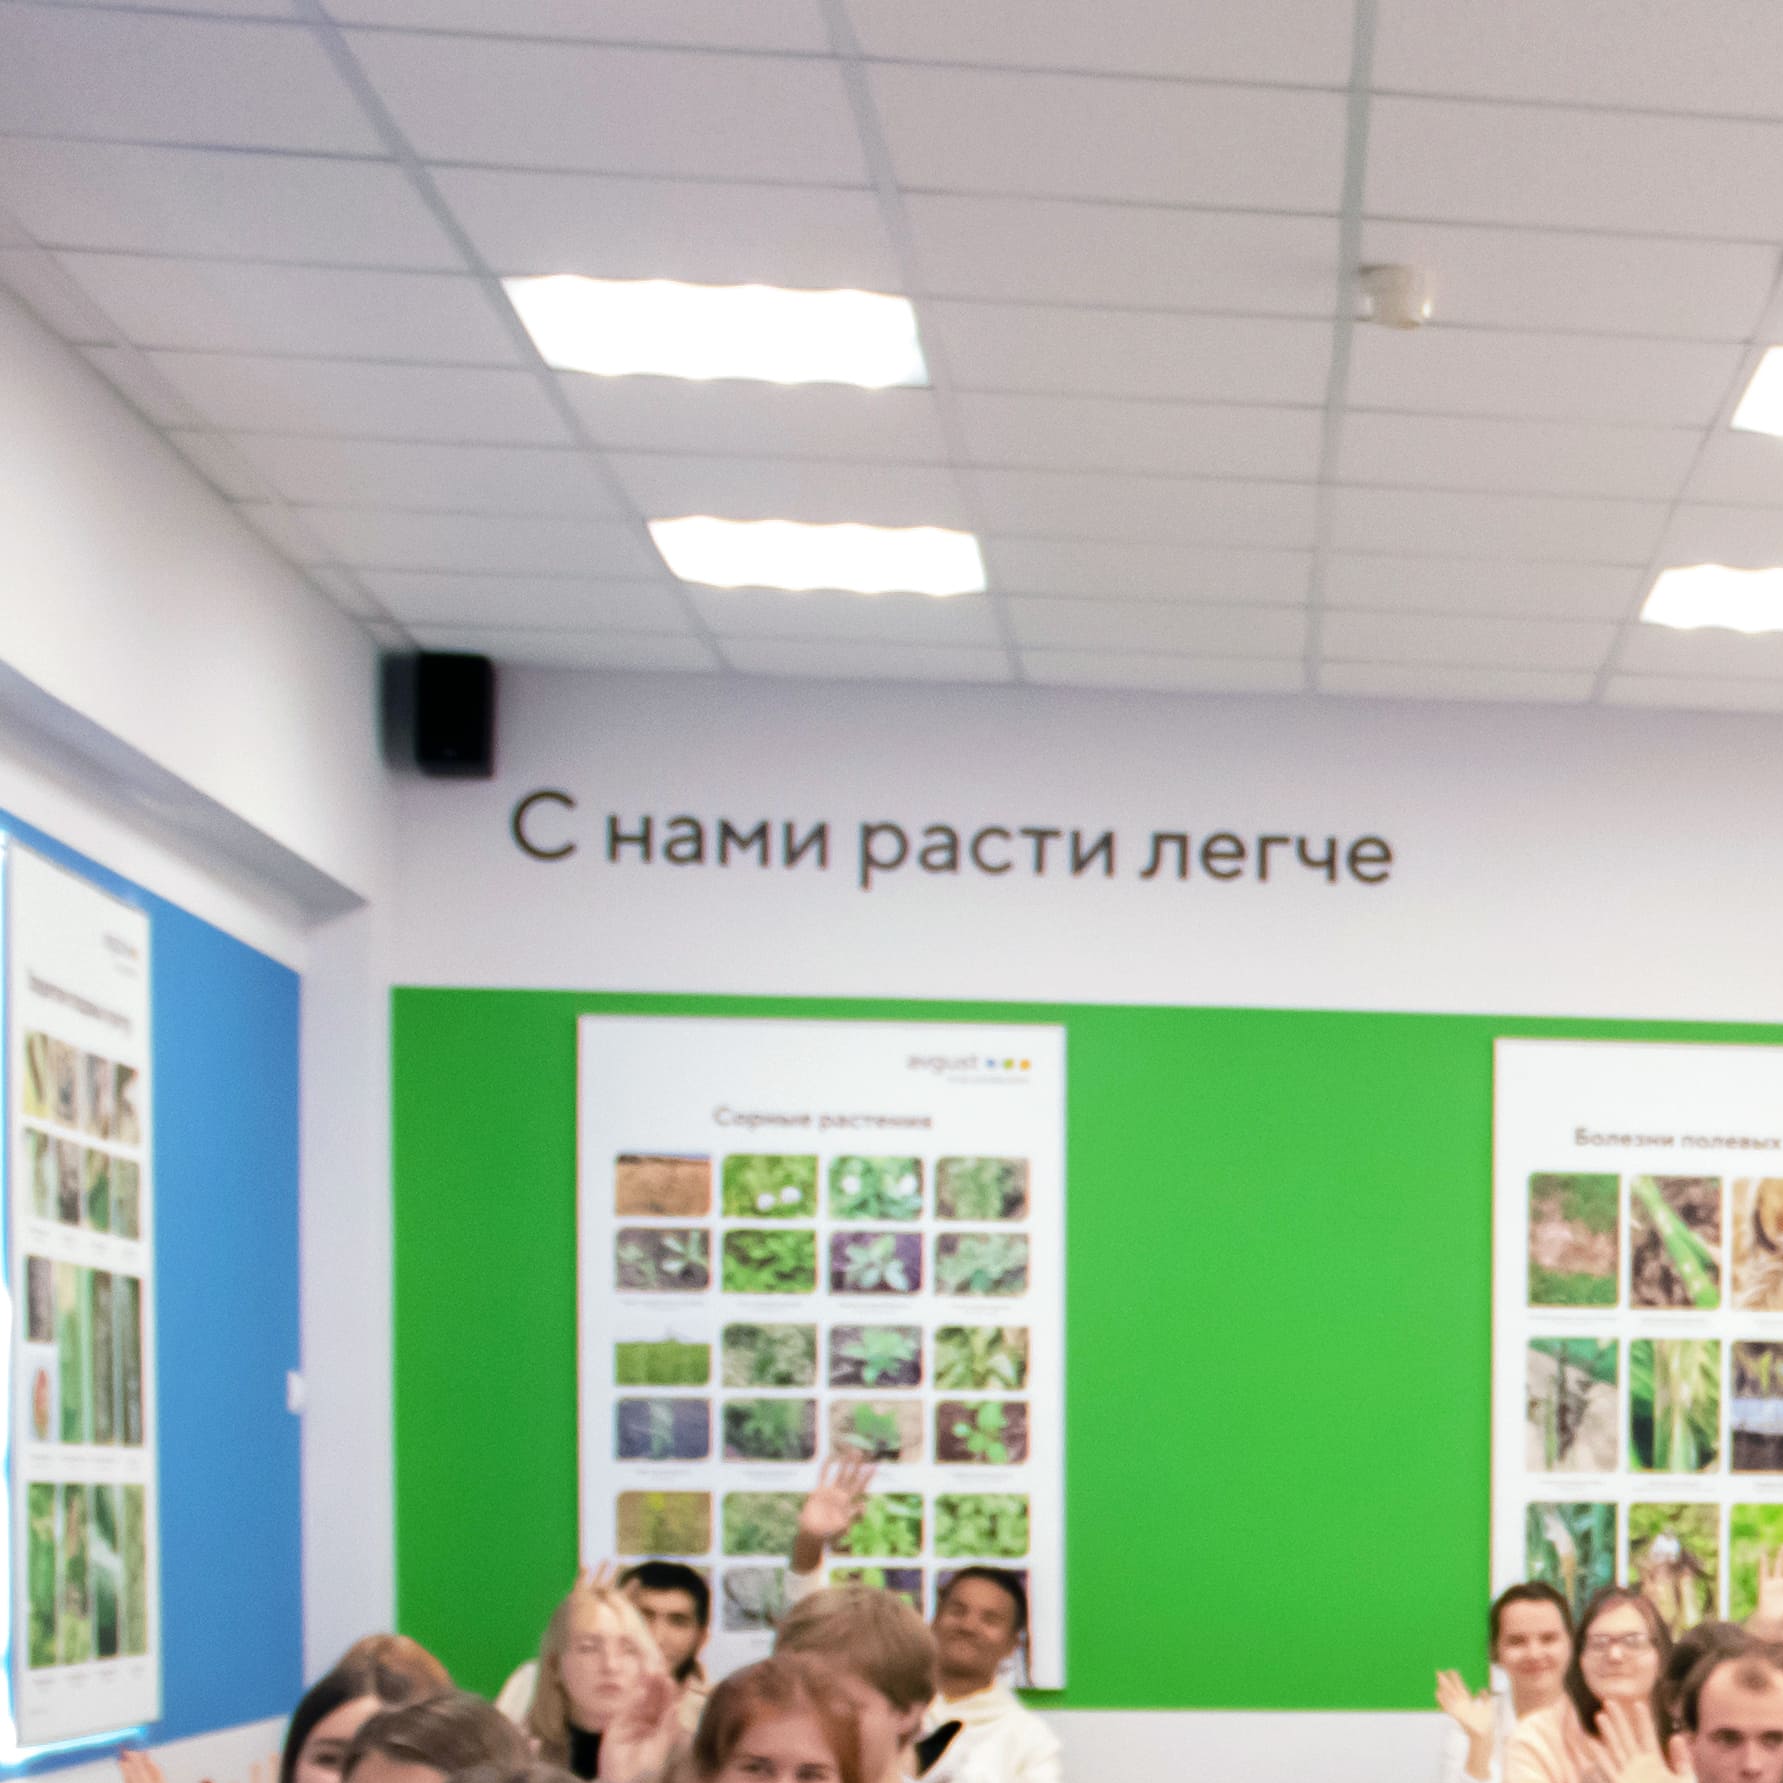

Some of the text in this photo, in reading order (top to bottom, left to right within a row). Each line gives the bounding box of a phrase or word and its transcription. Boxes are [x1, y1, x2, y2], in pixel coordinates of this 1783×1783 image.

[509, 790, 1394, 890] С нами расти легче
[712, 1105, 933, 1132] Сорные растения
[1574, 1126, 1675, 1148] Болезни
[1681, 1134, 1782, 1152] полевых
